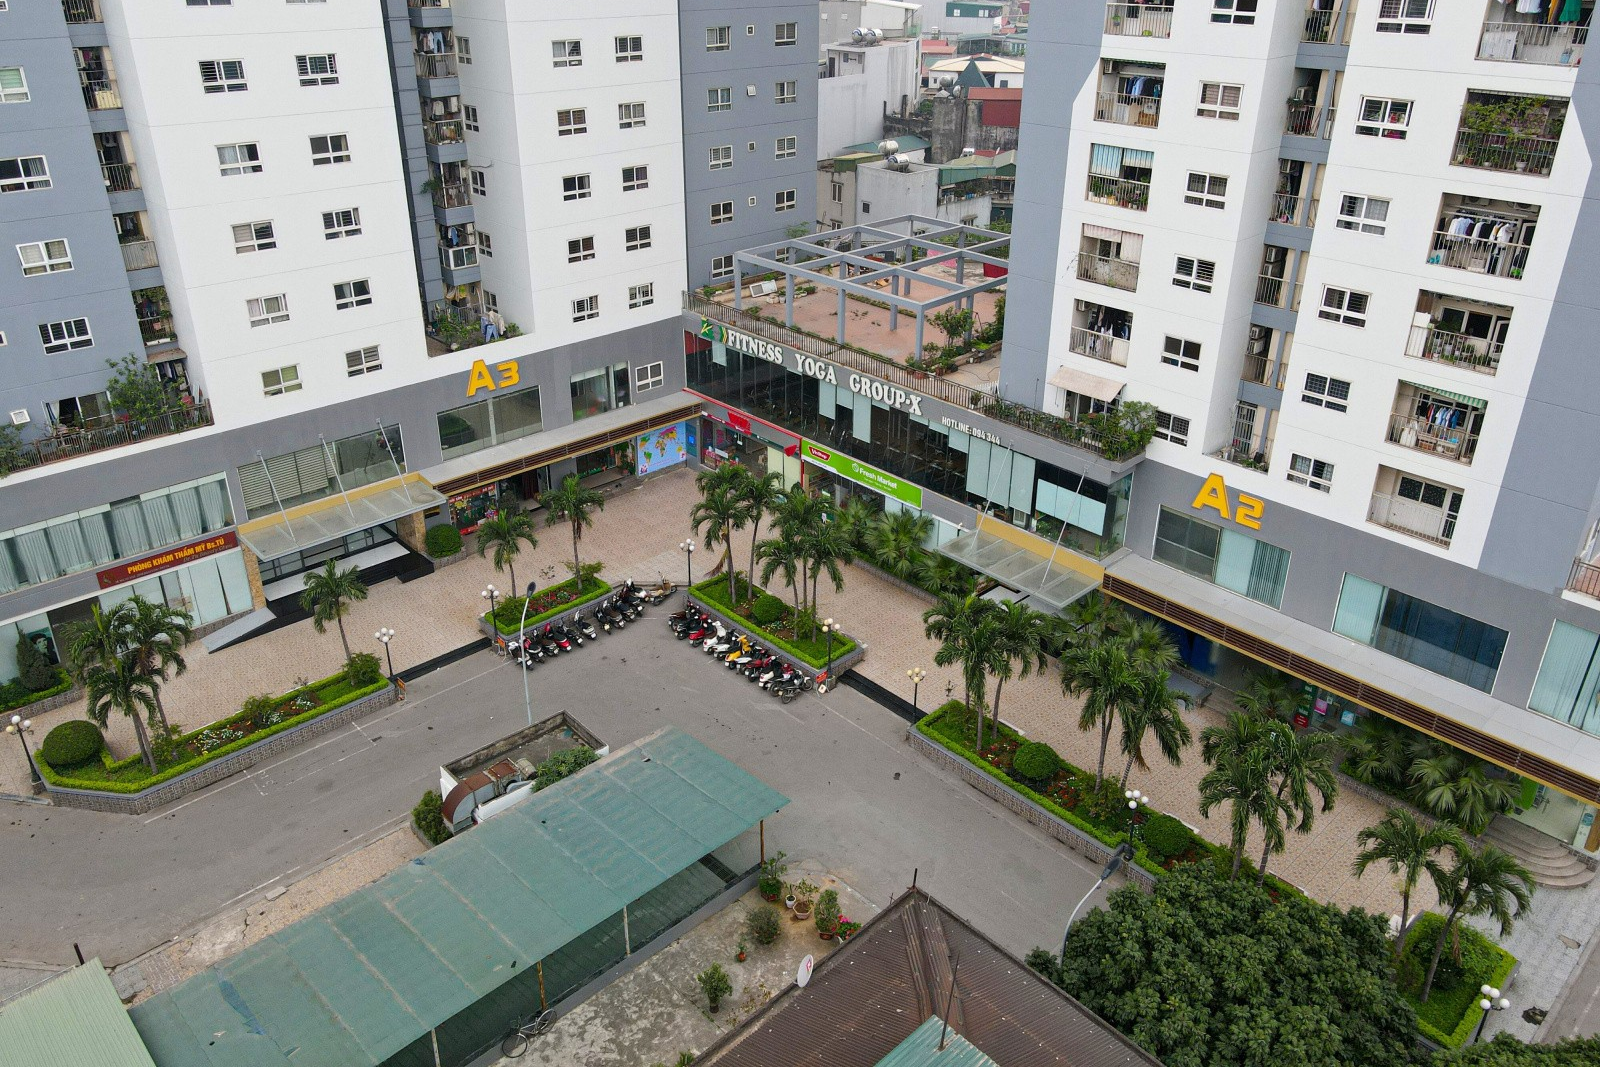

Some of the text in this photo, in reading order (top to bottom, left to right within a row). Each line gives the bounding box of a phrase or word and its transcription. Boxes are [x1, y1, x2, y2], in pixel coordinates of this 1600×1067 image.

[727, 329, 783, 365] FITNESS
[794, 353, 838, 386] YOGA
[466, 358, 521, 398] A3
[941, 416, 972, 435] HOTLINE:
[859, 467, 877, 480] Fresh
[877, 475, 898, 489] Market
[1191, 472, 1265, 531] A2
